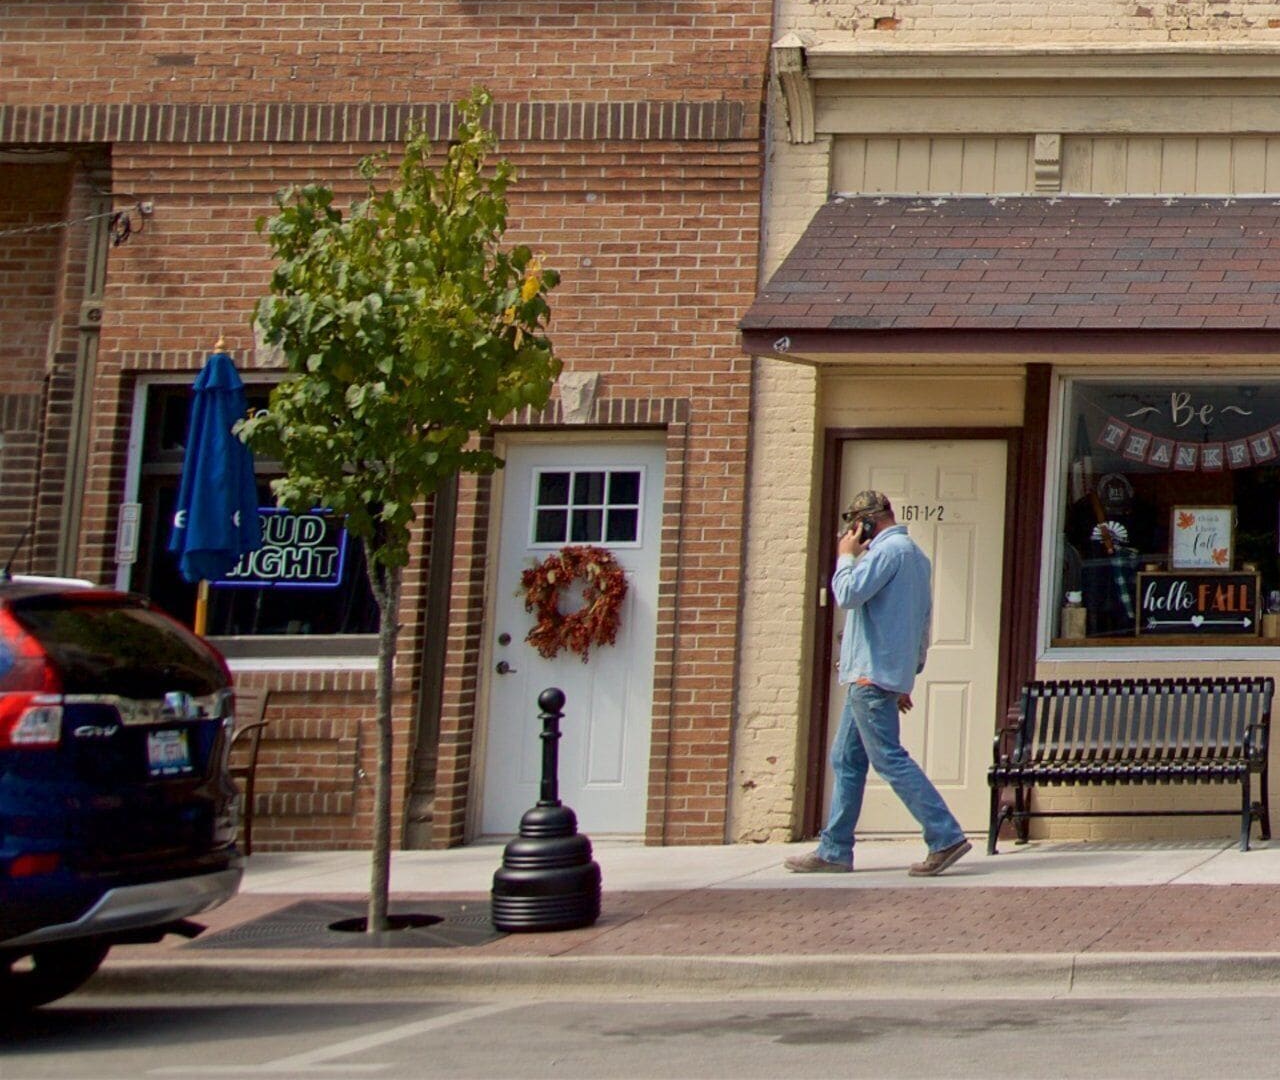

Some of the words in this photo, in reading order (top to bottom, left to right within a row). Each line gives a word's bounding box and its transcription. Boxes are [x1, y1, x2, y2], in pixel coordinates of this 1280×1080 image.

[1171, 392, 1214, 427] Be
[901, 505, 944, 521] 167-1/2
[261, 515, 327, 546] UD
[1192, 532, 1218, 557] fall
[1143, 580, 1196, 612] hello
[1198, 583, 1251, 612] FALL
